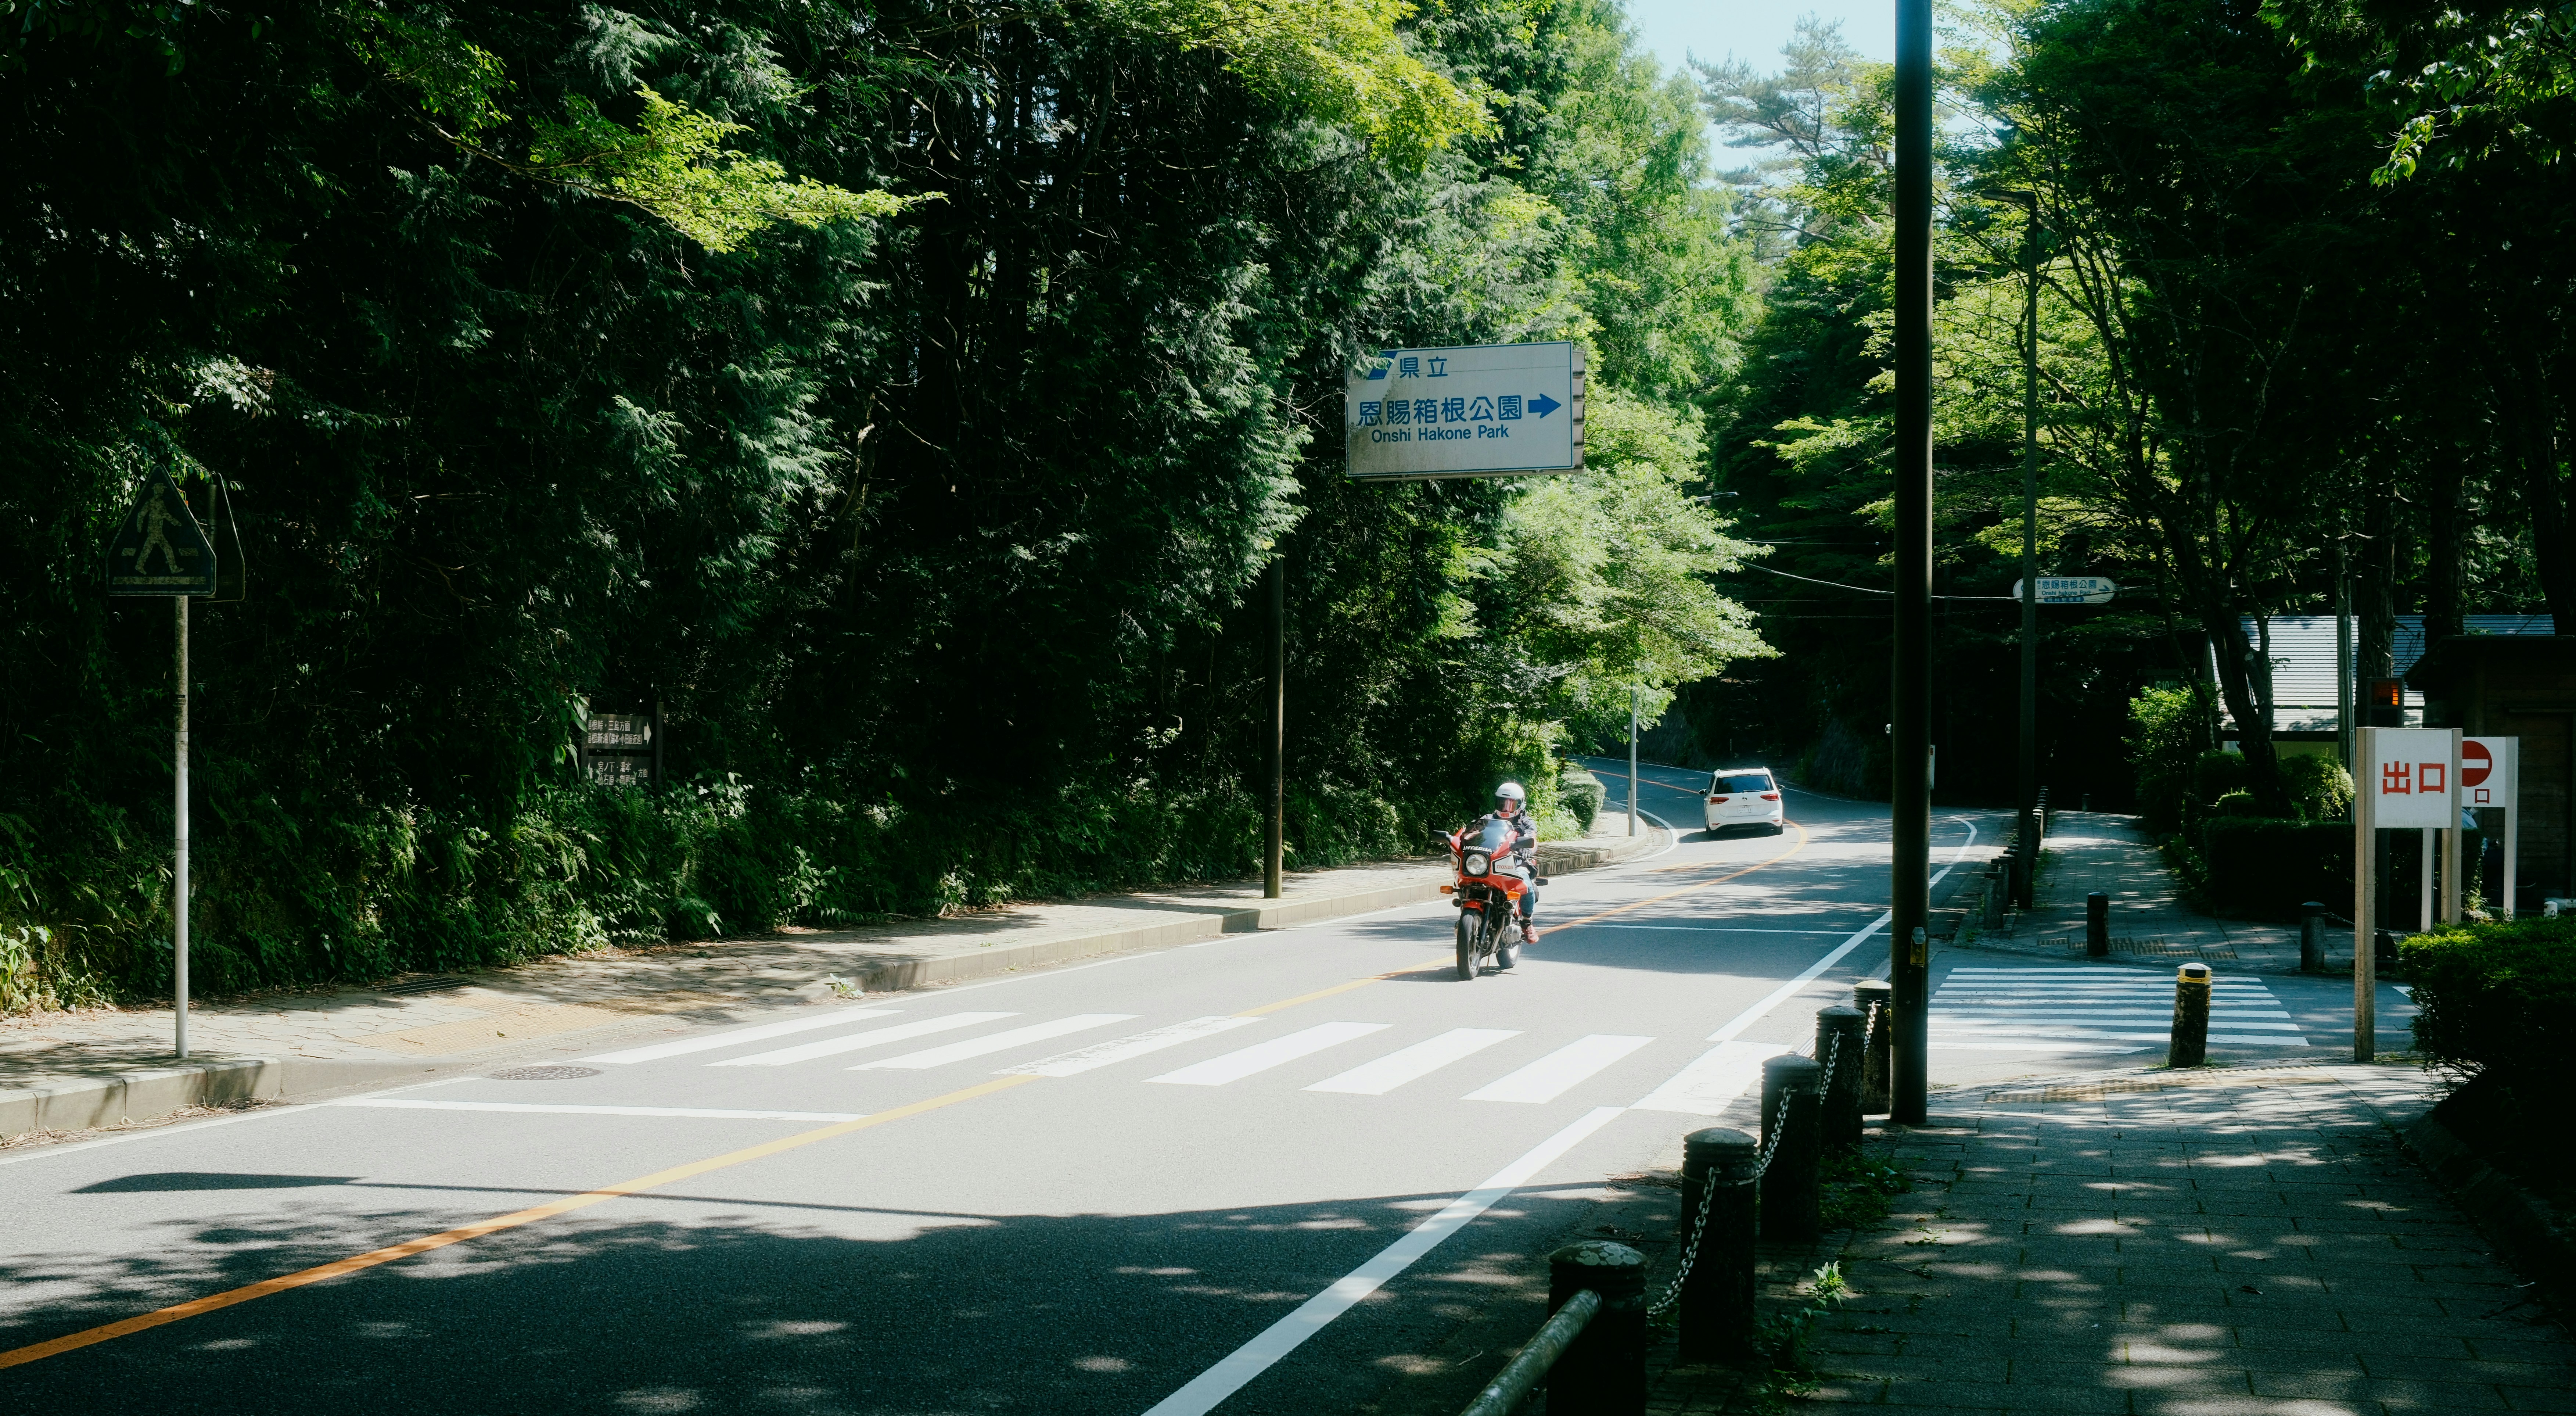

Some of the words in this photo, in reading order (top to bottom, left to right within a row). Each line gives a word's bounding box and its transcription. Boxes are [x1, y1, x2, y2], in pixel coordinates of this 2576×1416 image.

[1400, 356, 1448, 378] 県立
[1357, 395, 1522, 426] 恩賜箱根公園
[1372, 428, 1411, 443] Onshi
[1418, 427, 1471, 441] Hakone
[1478, 424, 1509, 439] Park
[2042, 580, 2097, 589] 恩賜箱根公園
[2383, 761, 2445, 795] 出口
